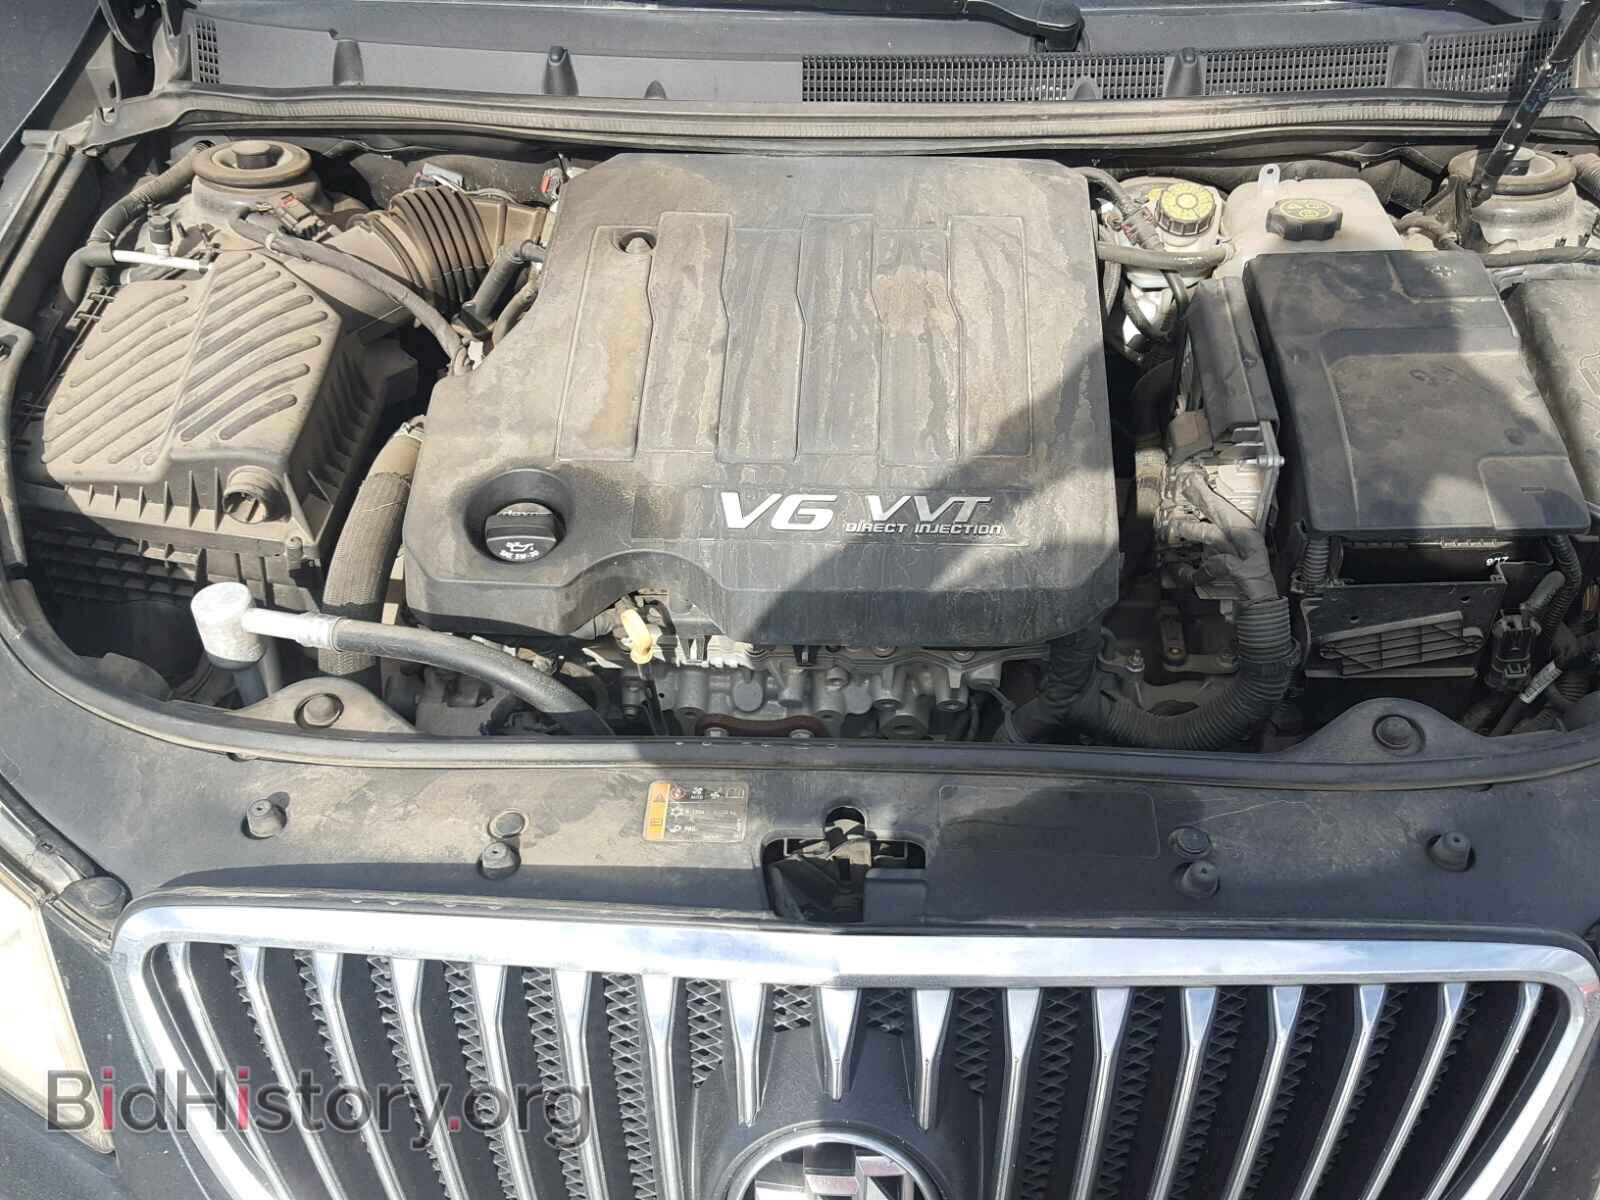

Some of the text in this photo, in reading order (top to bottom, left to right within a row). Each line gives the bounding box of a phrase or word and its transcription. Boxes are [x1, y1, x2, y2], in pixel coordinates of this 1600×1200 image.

[720, 492, 992, 531] V6 VVT
[845, 521, 1003, 536] DIRECT INJECTION
